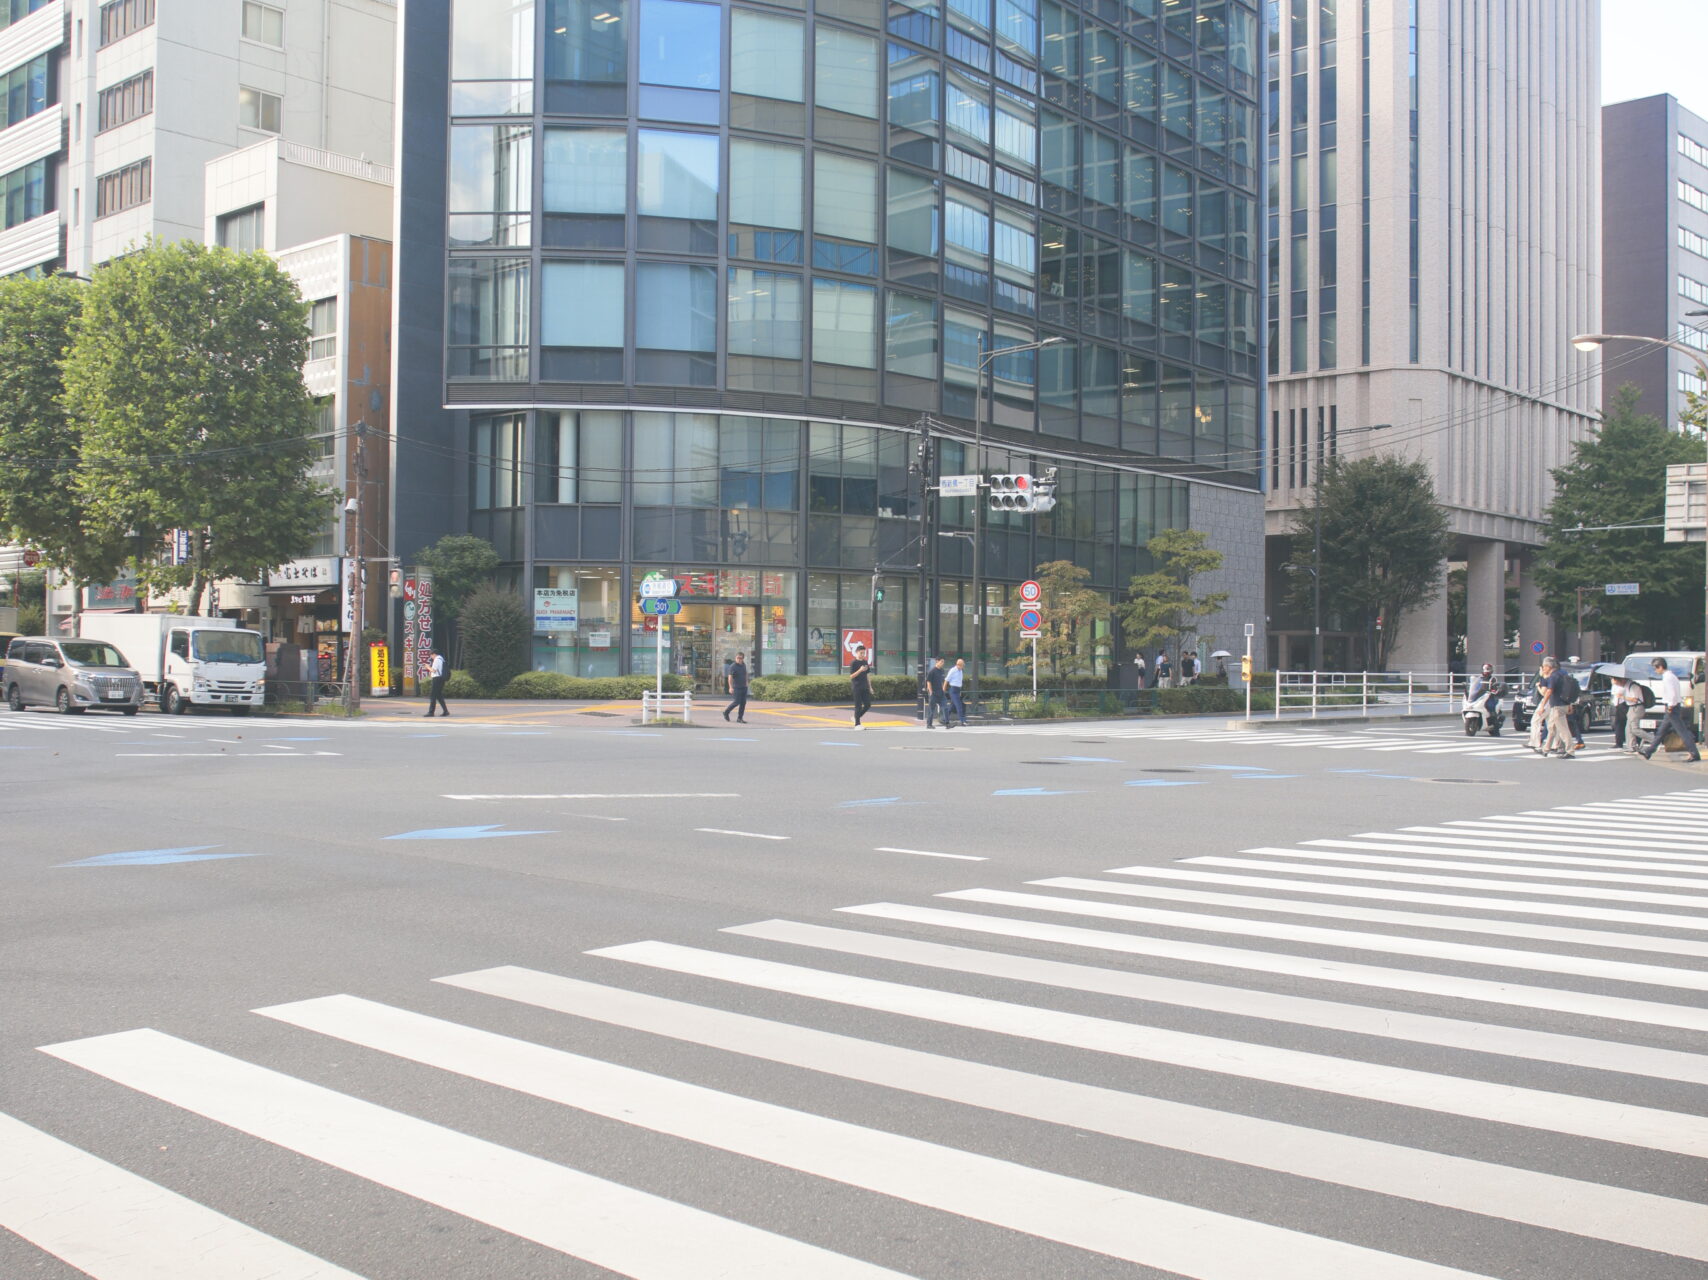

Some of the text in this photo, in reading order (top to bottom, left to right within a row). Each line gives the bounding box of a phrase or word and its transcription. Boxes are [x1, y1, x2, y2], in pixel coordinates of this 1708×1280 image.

[1024, 586, 1036, 596] 50
[656, 602, 667, 612] 301
[377, 649, 386, 686] 処方せん
